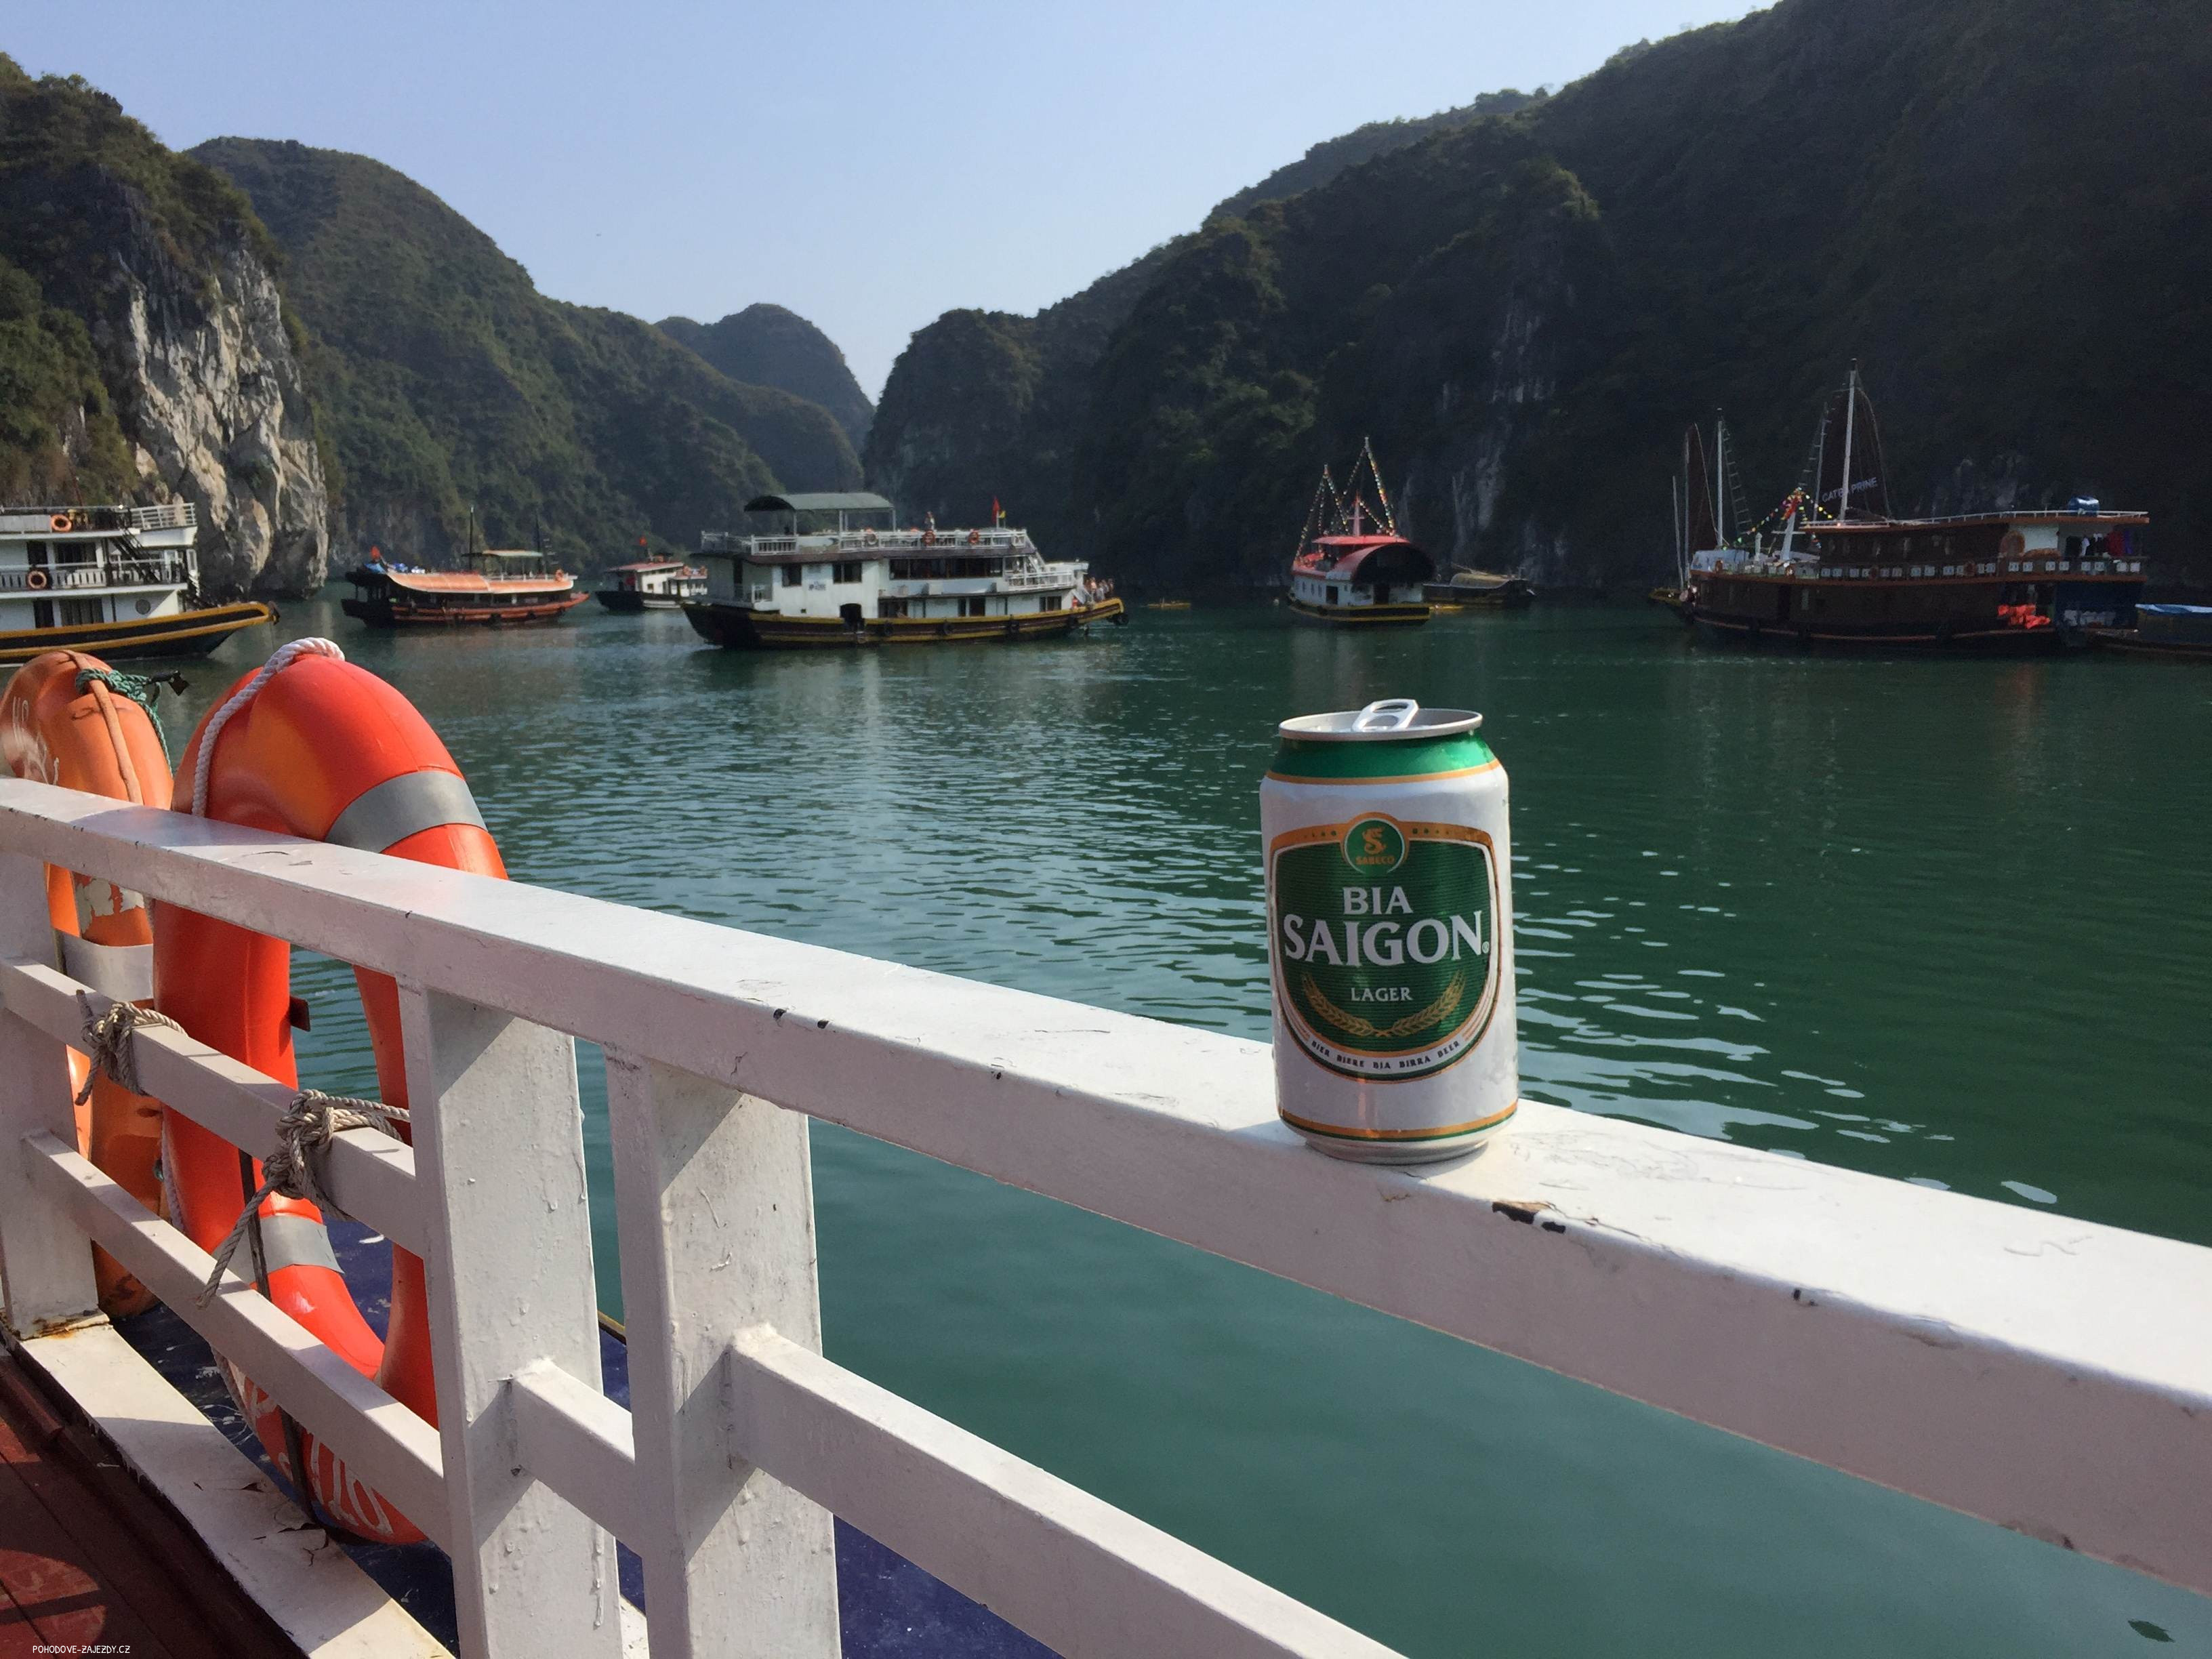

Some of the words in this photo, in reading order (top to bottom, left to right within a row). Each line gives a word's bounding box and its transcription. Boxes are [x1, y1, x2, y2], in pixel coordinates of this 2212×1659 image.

[1355, 856, 1395, 865] SABECO
[1343, 886, 1414, 915] BIA
[1351, 987, 1413, 1002] LAGER
[1311, 1040, 1330, 1057] BIER
[1336, 1054, 1365, 1068] BIERE
[1373, 1061, 1391, 1069] BIA
[1399, 1055, 1431, 1069] BIRRA
[1437, 1040, 1460, 1058] BEER
